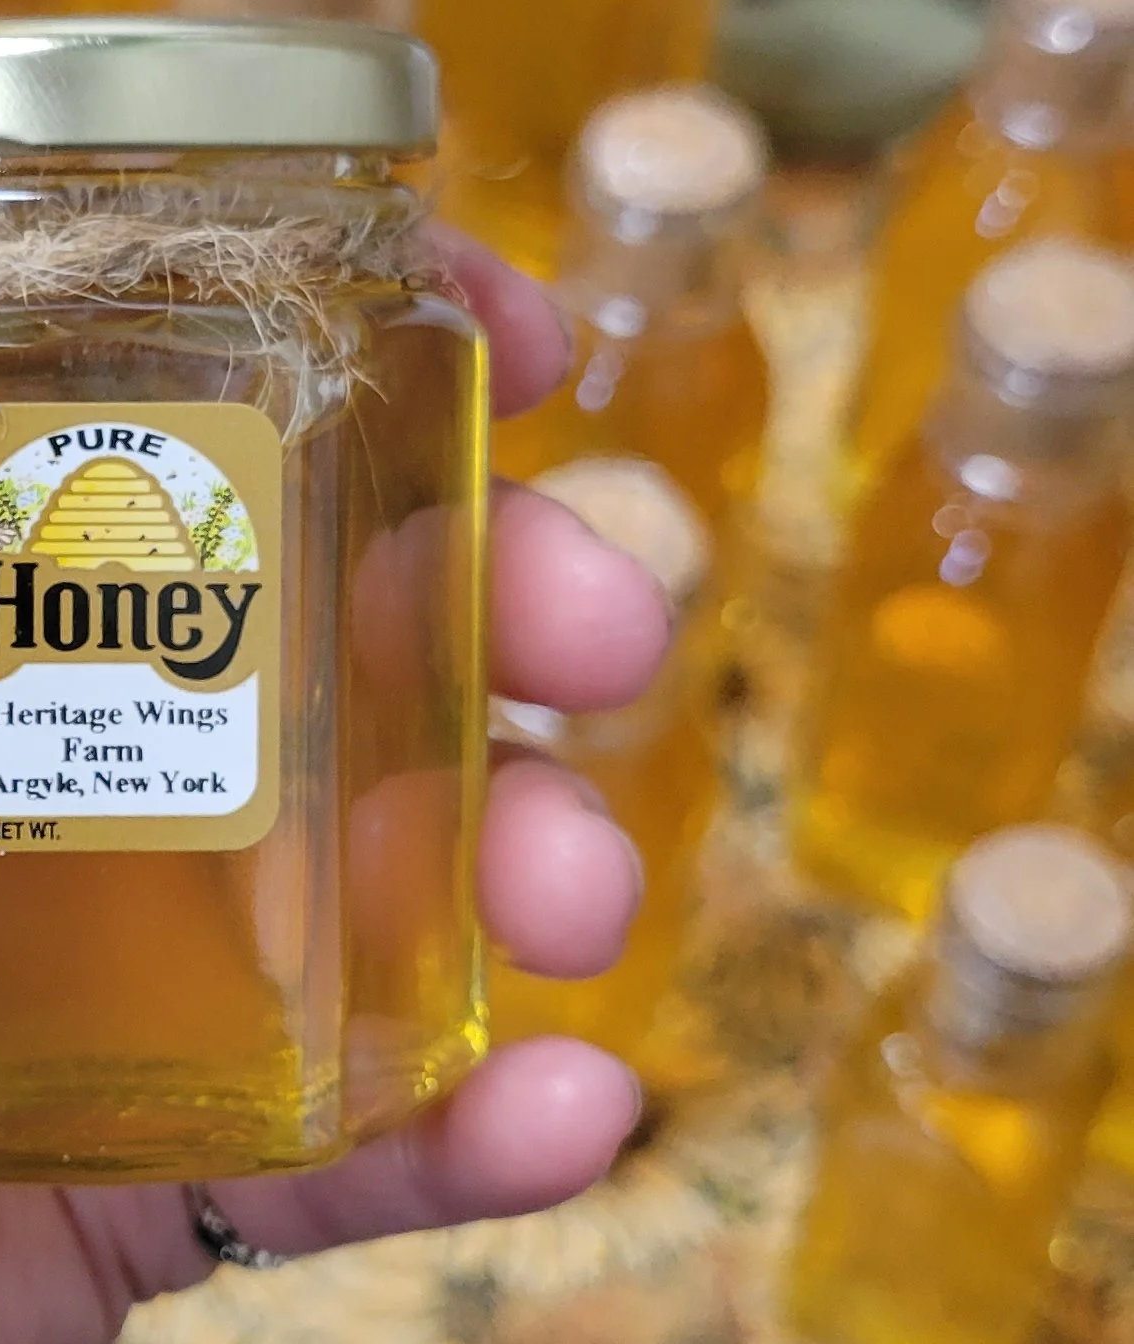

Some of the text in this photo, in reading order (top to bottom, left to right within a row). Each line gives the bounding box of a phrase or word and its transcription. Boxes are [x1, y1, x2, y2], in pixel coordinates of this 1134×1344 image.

[47, 428, 167, 457] PURE
[133, 700, 228, 730] Wings
[62, 737, 144, 762] Farm
[93, 771, 150, 794] New
[160, 770, 228, 794] York
[29, 822, 61, 841] WT.
